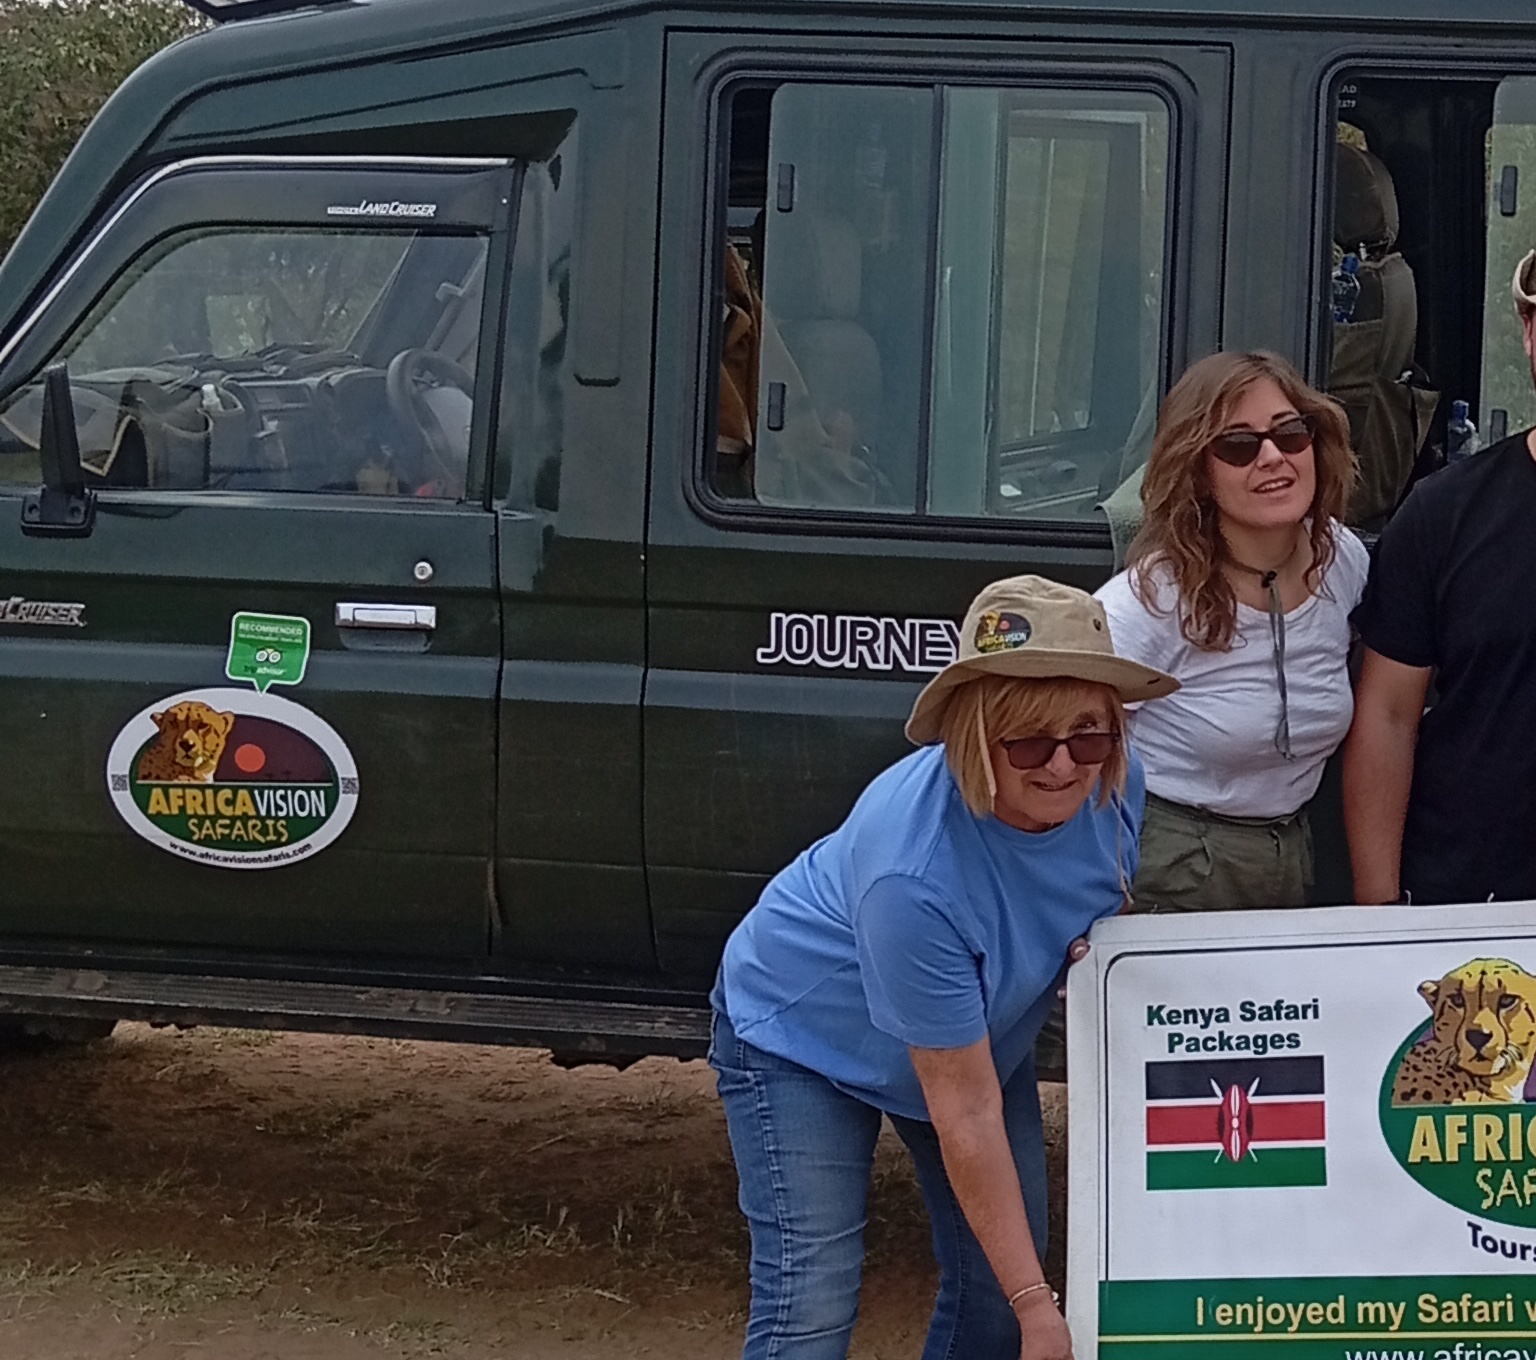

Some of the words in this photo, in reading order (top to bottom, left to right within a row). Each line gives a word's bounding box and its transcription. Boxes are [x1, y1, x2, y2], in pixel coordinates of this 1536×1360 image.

[187, 818, 290, 844] SAFARIS
[169, 840, 313, 866] www.africavisionsafaris.com
[1146, 1003, 1232, 1030] Kenya
[1238, 997, 1320, 1023] Safari
[1167, 1030, 1302, 1056] Packages
[1196, 1296, 1205, 1326] I
[1214, 1295, 1346, 1333] enjoyed
[1356, 1300, 1407, 1331] my
[1417, 1293, 1515, 1323] Safari
